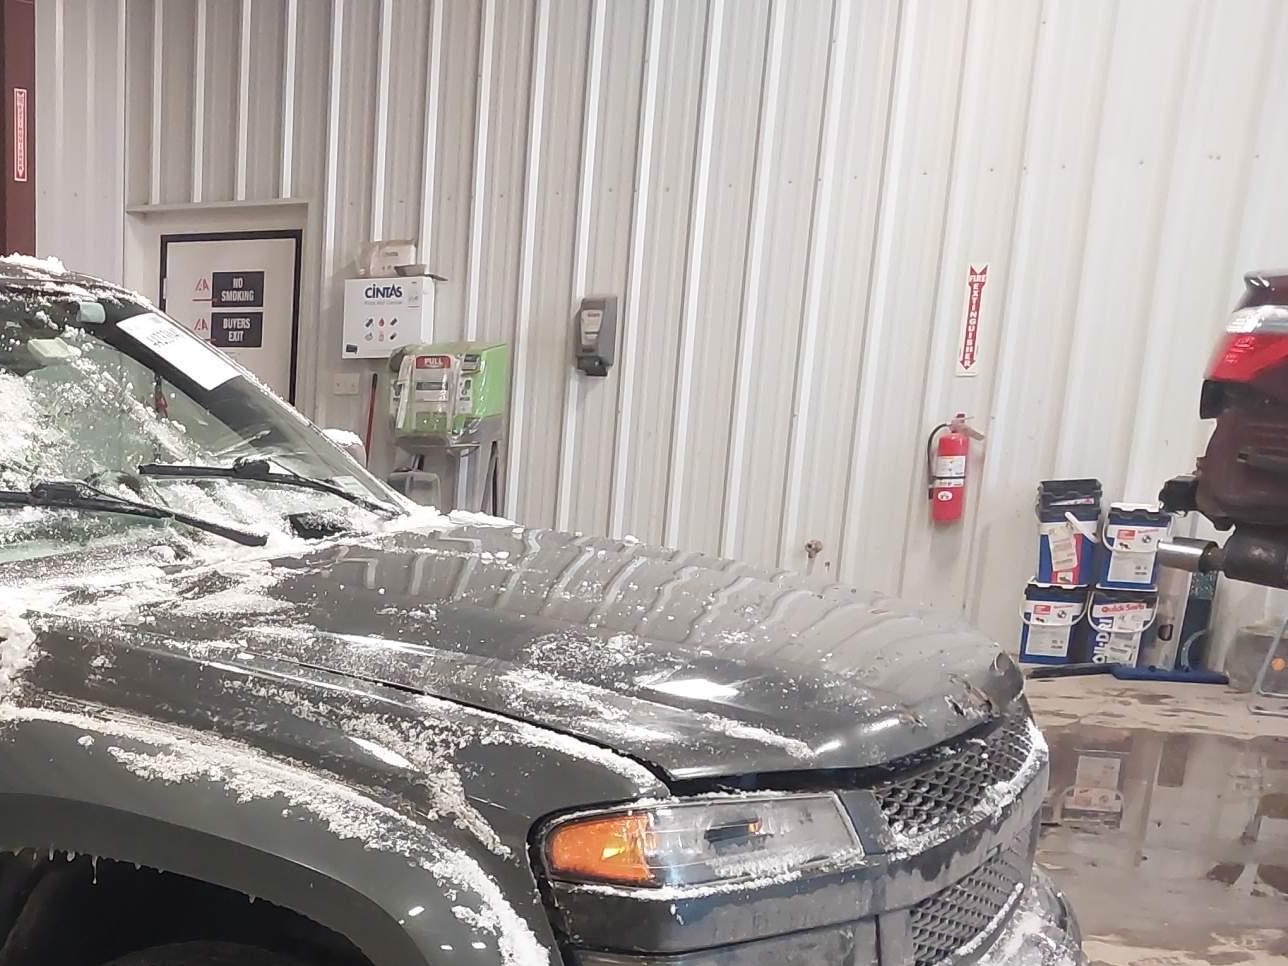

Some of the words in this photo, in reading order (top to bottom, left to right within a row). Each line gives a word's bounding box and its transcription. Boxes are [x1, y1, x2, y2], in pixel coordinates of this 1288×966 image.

[232, 277, 244, 289] NO
[221, 290, 255, 302] SMOKING
[222, 318, 251, 329] BUYERS
[963, 282, 980, 367] EXTINGUISHER
[228, 330, 244, 342] EXIT
